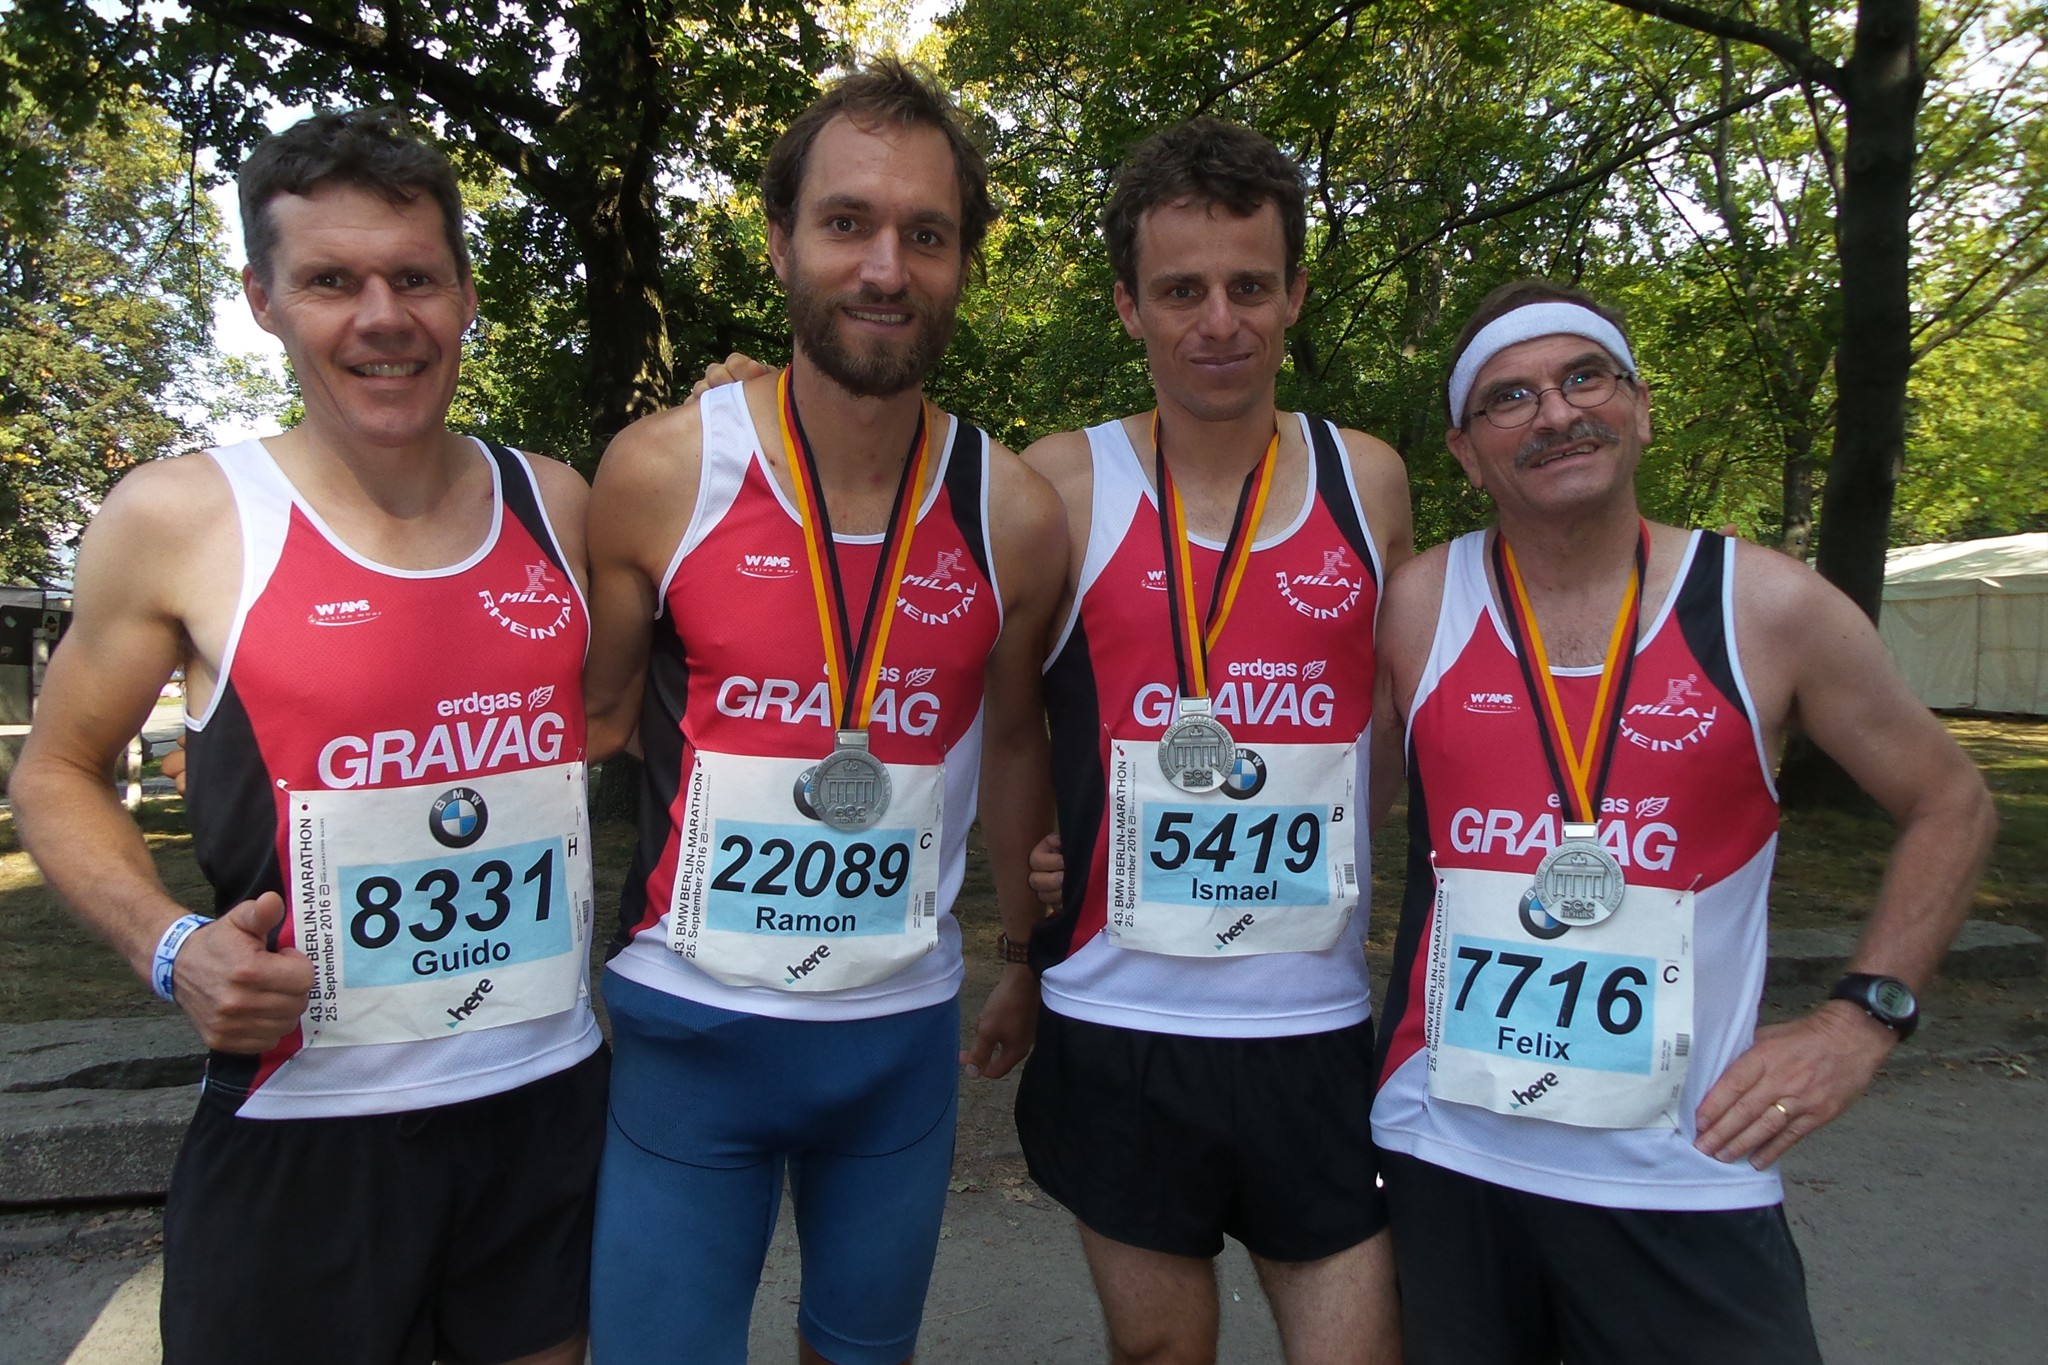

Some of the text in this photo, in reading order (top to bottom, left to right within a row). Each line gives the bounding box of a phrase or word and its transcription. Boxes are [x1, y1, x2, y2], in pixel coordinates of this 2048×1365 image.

[744, 554, 791, 568] W'AMS
[314, 599, 371, 617] W'AMS
[478, 590, 572, 640] RHEINTAL
[896, 581, 978, 626] HEINTAL
[1275, 571, 1362, 620] RHEINTAL
[1228, 658, 1298, 680] erdgas
[436, 688, 523, 718] erdgas
[716, 676, 941, 737] GRAAG
[1470, 693, 1514, 706] W'AMS
[1619, 705, 1718, 752] HEINTAL
[317, 710, 566, 789] GRAVAG
[1237, 749, 1265, 768] MW
[435, 787, 483, 812] BMW
[1331, 806, 1344, 823] B
[567, 837, 578, 858] H
[680, 771, 704, 901] BERLIN-MARATHON
[919, 831, 933, 850] C
[1112, 760, 1127, 928] 43. BMW BERLIN-MARATHON
[1150, 811, 1321, 874] 5419
[1450, 807, 1679, 872] GRAAG
[710, 833, 912, 899] 22089
[1124, 827, 1138, 929] 25. September 2016
[299, 817, 319, 961] BERLIN-MARATHON
[349, 847, 555, 951] 8331
[686, 846, 709, 959] 25. September 2016
[1192, 877, 1278, 901] Ismael
[675, 901, 689, 936] BMW
[755, 906, 857, 933] Ramon
[1216, 912, 1255, 945] here
[318, 899, 338, 1023] 25. September 2016
[411, 938, 512, 976] Guido
[787, 943, 831, 979] here
[1427, 889, 1444, 1015] BERLIN-MARATHON
[1454, 945, 1648, 1035] 7716
[1663, 964, 1680, 984] C
[311, 1001, 323, 1023] 43.
[447, 977, 495, 1021] here
[1429, 961, 1447, 1072] 25. September 2016
[1497, 1026, 1571, 1061] Felix
[1512, 1070, 1560, 1106] here
